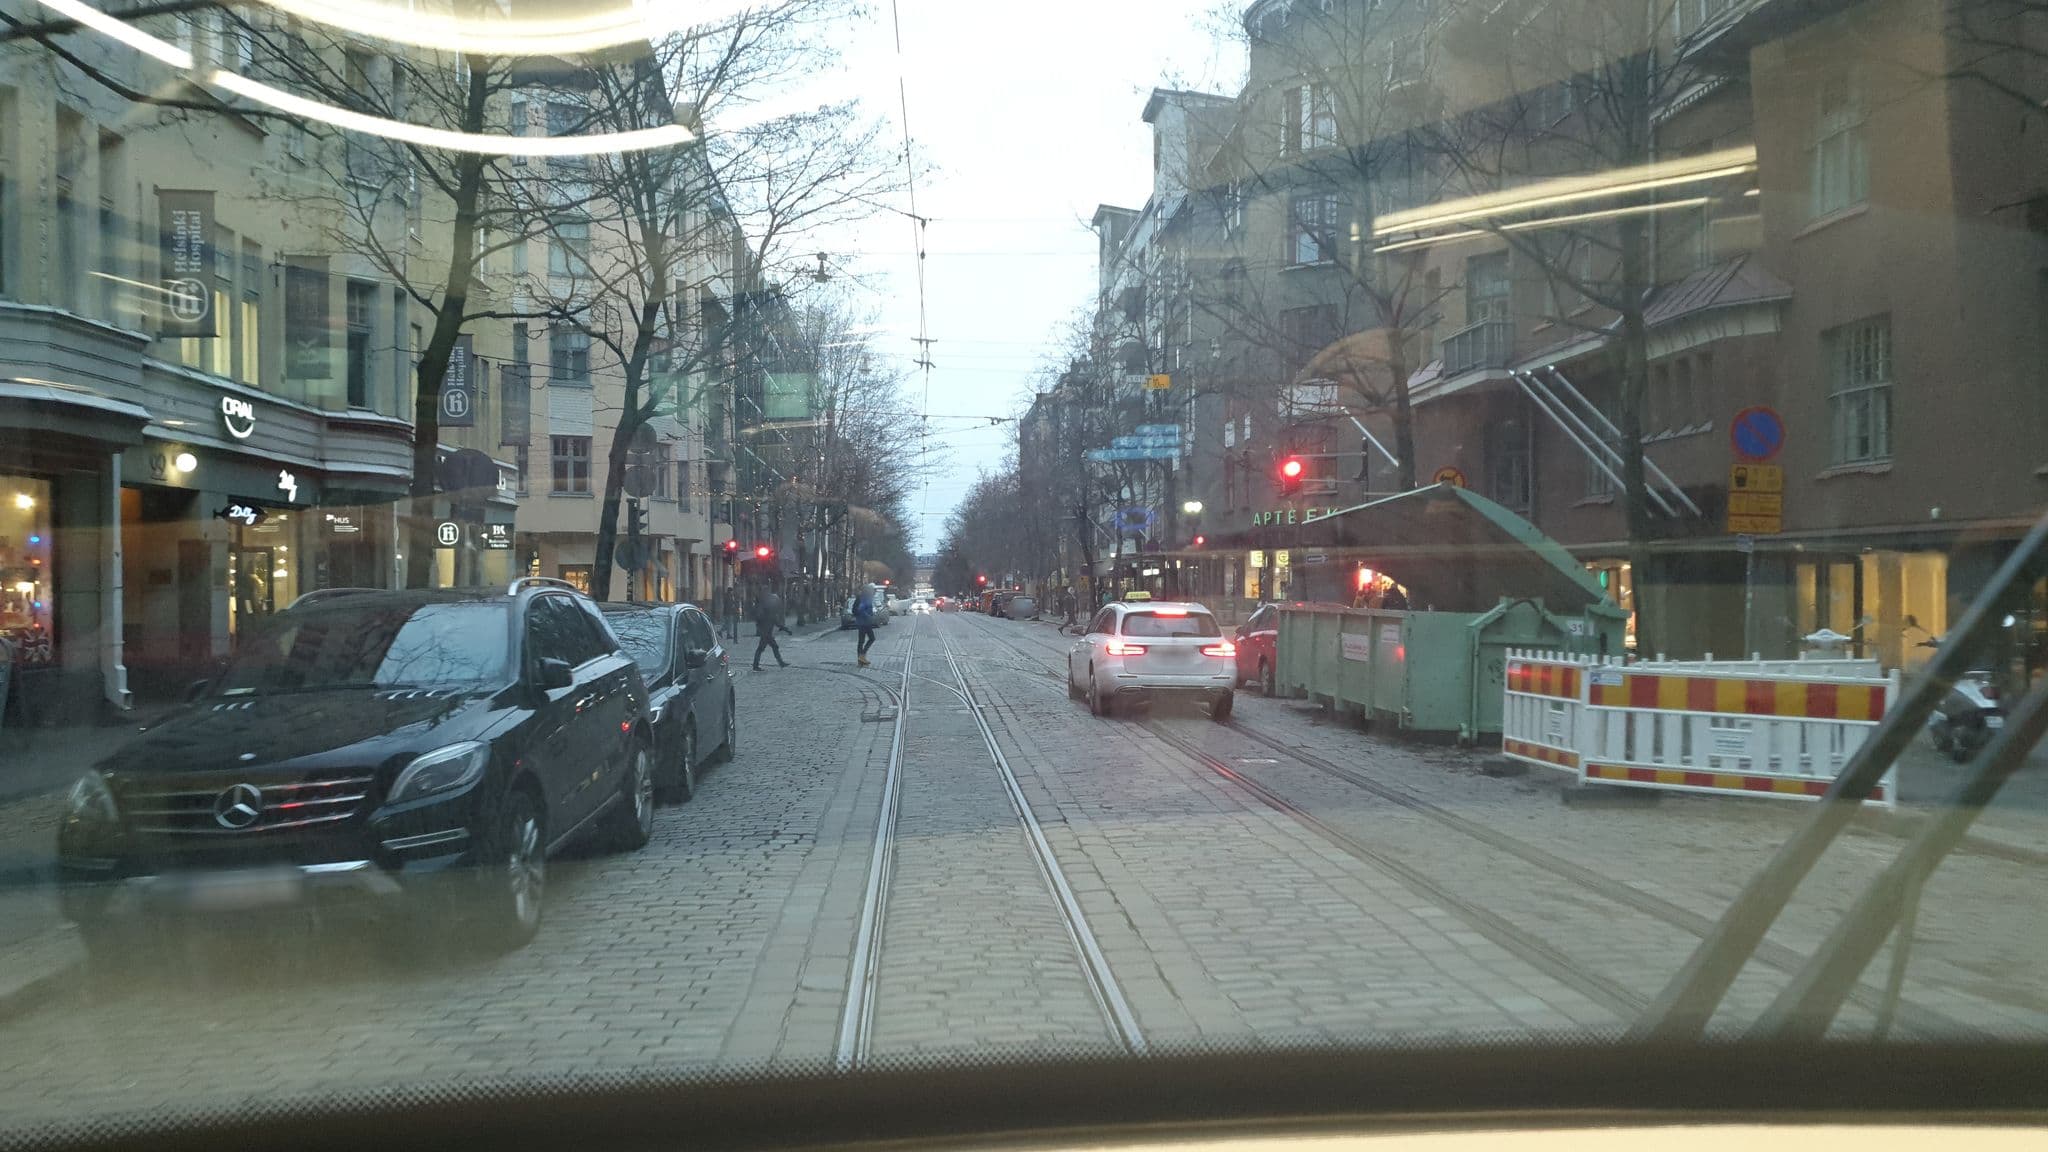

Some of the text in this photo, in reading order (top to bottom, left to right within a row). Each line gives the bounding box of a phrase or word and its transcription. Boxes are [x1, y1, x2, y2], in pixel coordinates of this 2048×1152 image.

[173, 210, 187, 273] Helsinki
[188, 210, 205, 273] Hospital
[222, 396, 256, 420] ORAL
